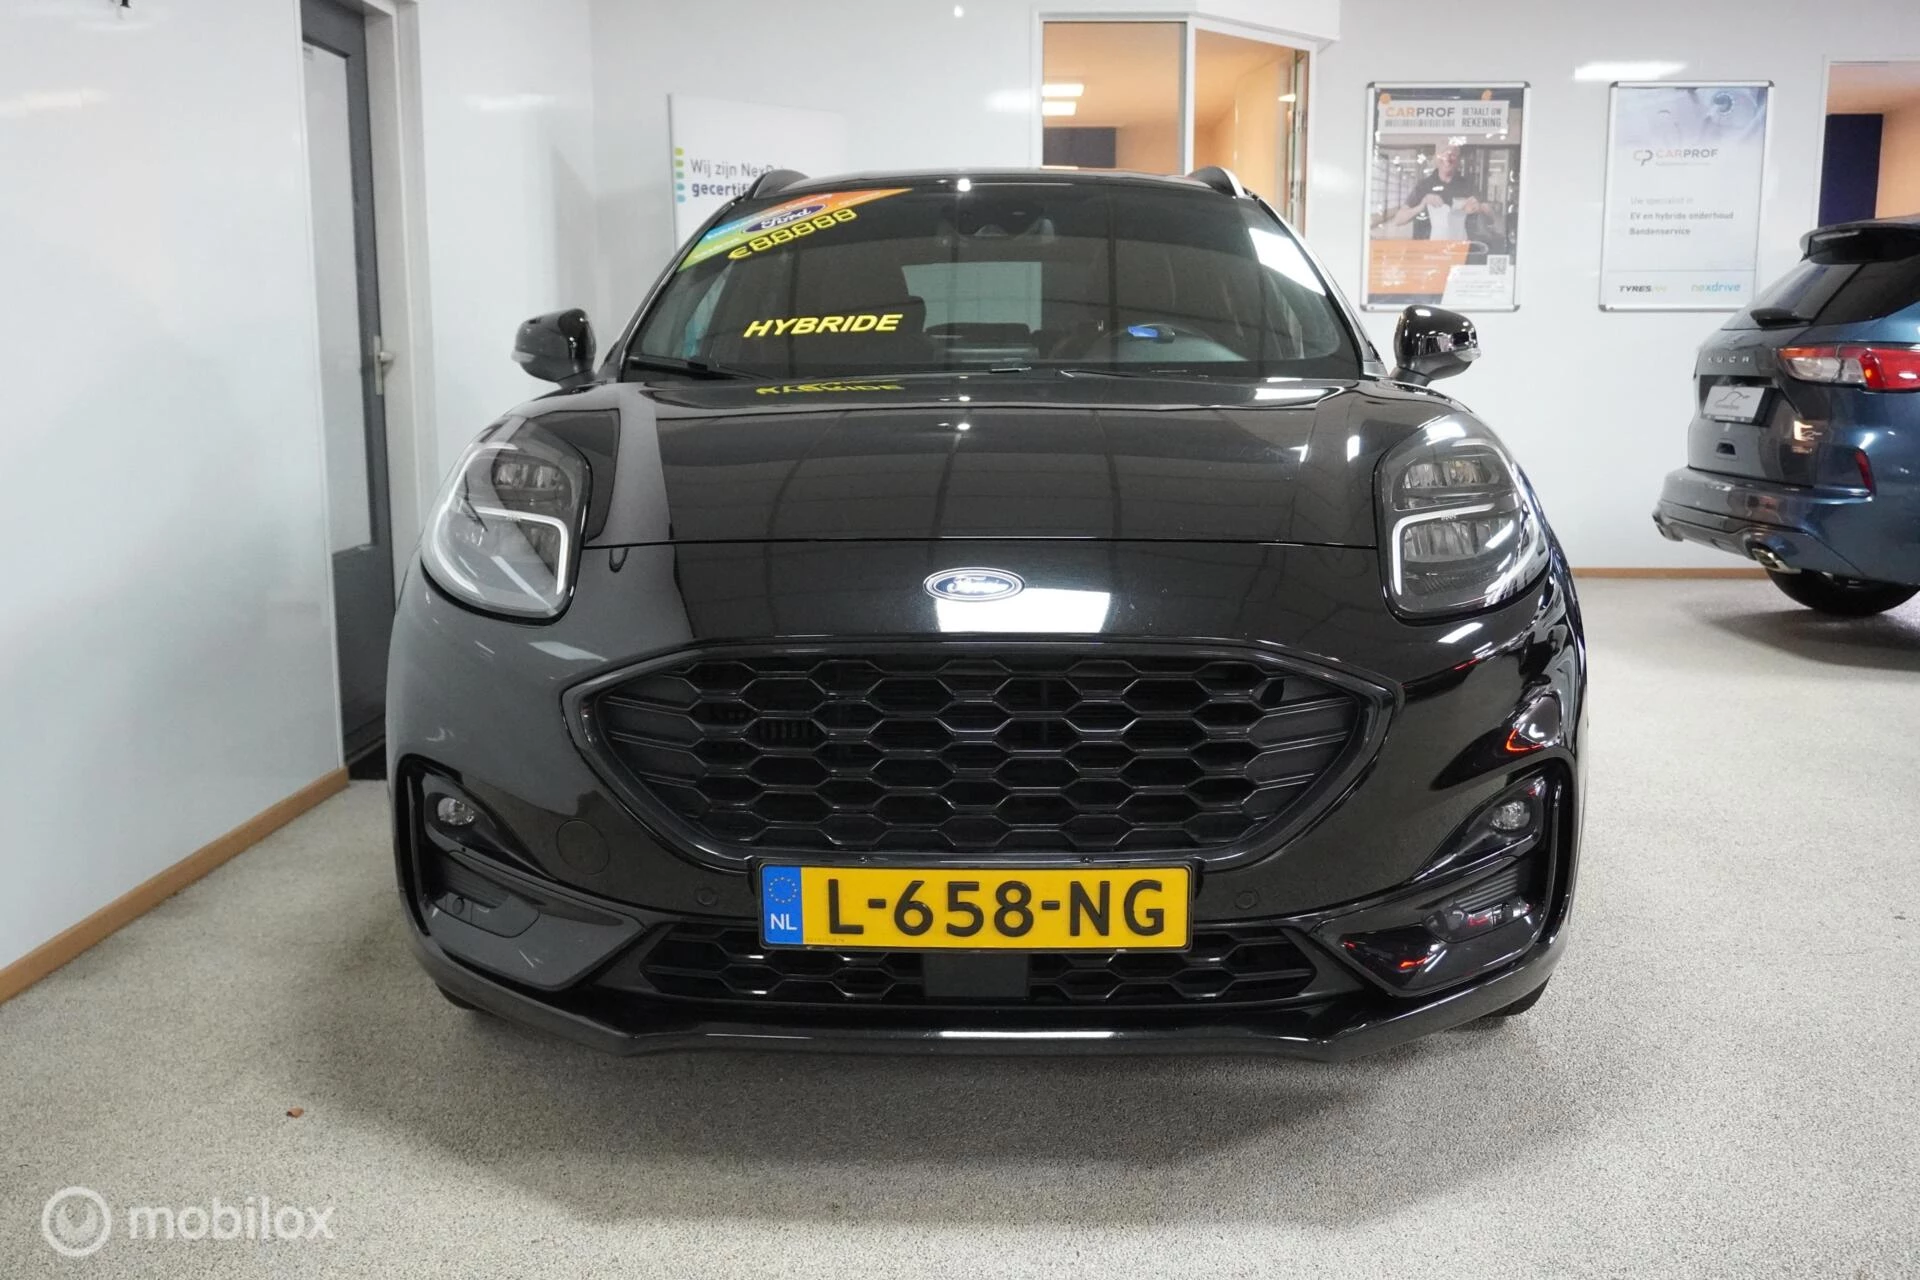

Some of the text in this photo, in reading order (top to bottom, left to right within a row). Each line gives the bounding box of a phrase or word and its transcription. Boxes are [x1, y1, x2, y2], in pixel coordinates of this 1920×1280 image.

[1386, 107, 1455, 118] CARPROF
[1462, 118, 1501, 128] REKENING
[1656, 149, 1718, 158] CARPROF
[690, 159, 711, 178] Wij
[715, 161, 737, 179] zijn
[761, 208, 812, 229] Ford
[1629, 227, 1691, 235] Bandenservice
[743, 313, 904, 338] HYBRIDE
[828, 878, 1165, 938] L-658-NG
[770, 913, 797, 931] NL
